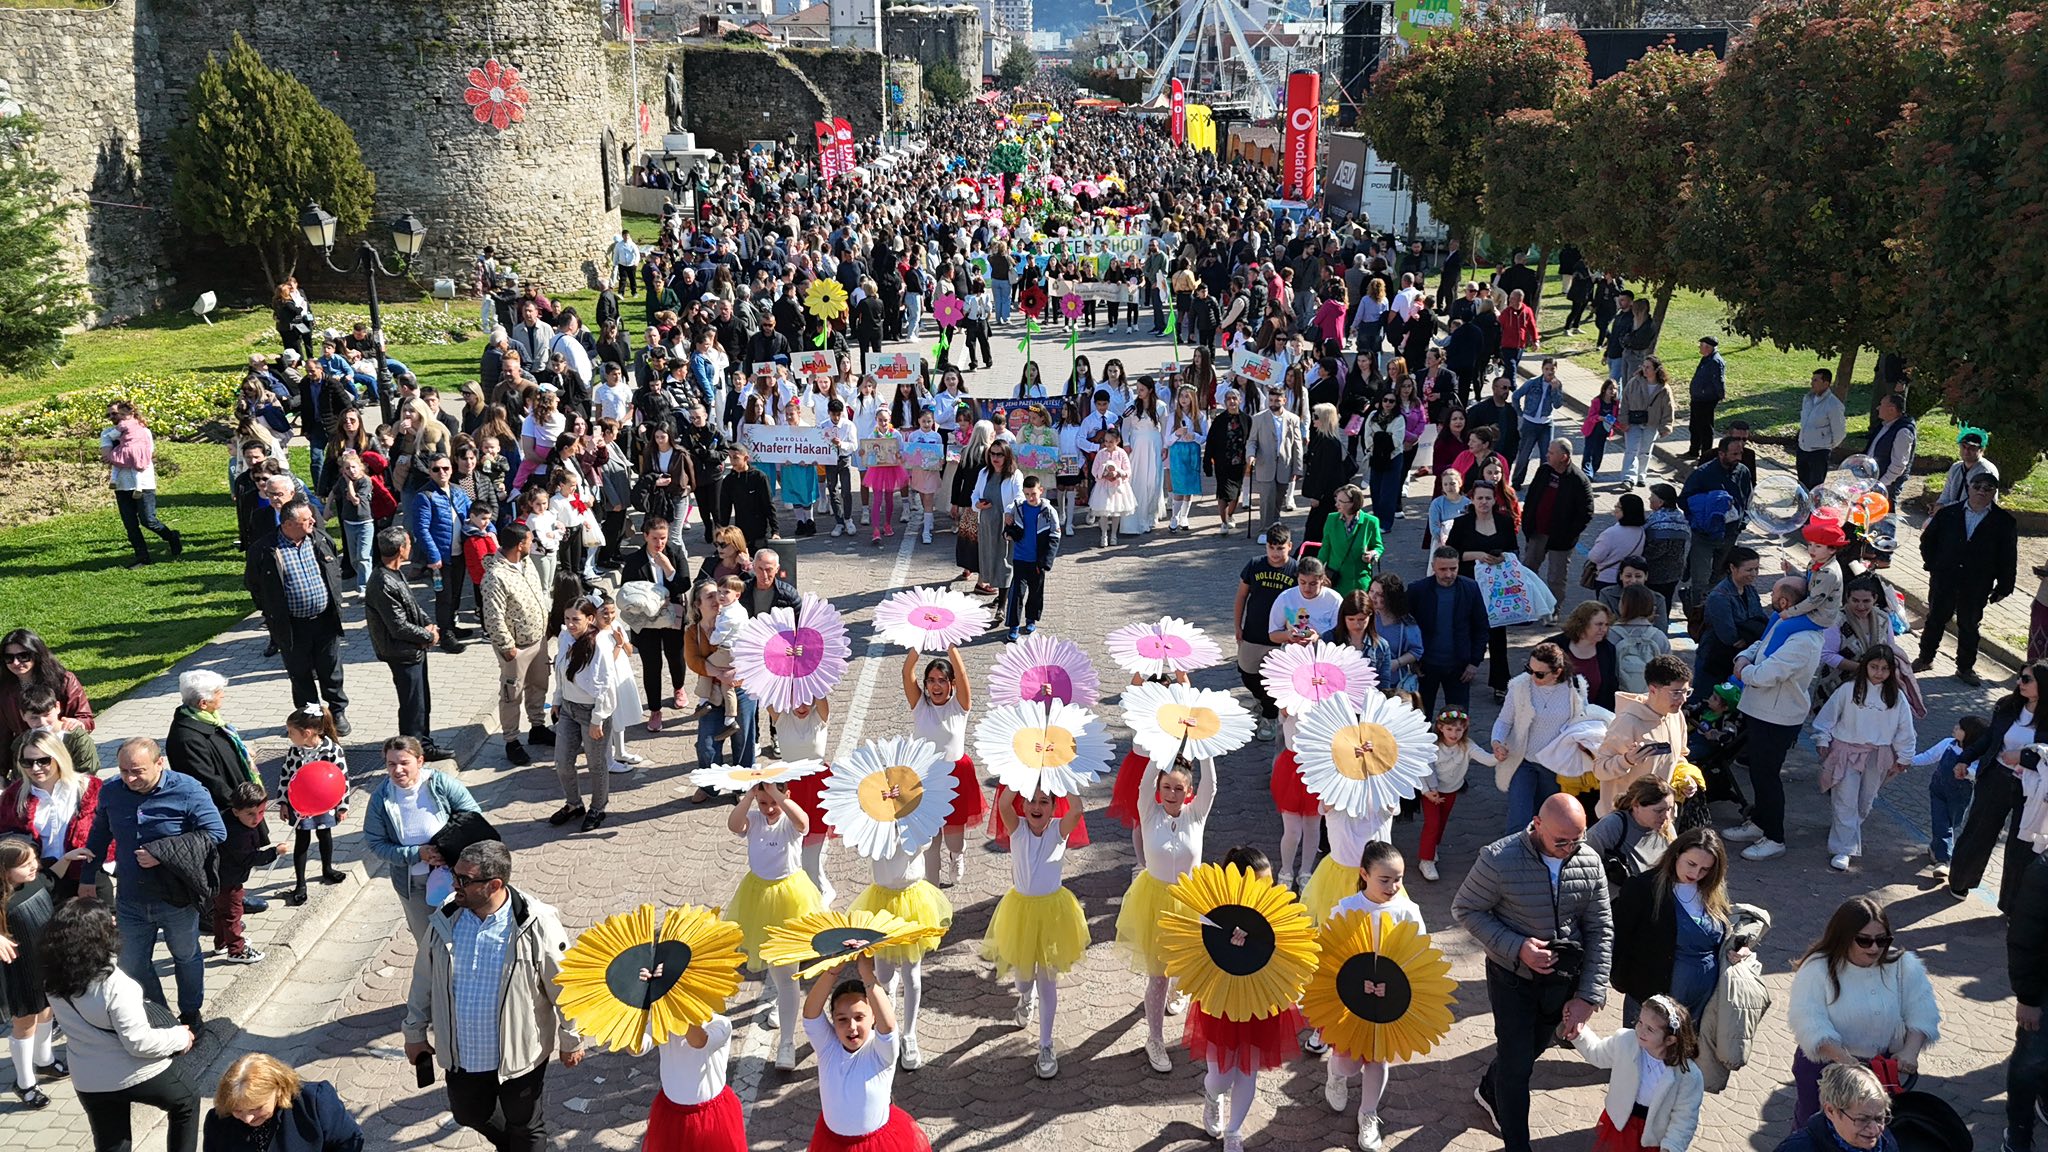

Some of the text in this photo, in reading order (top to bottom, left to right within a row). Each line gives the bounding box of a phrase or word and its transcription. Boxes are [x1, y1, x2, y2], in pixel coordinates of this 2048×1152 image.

[1409, 8, 1453, 26] VERËS
[1294, 133, 1307, 196] vodafone
[801, 359, 827, 370] JEMI
[752, 442, 832, 455] Xhaferr Hakani
[1254, 571, 1294, 586] HOLLISTER
